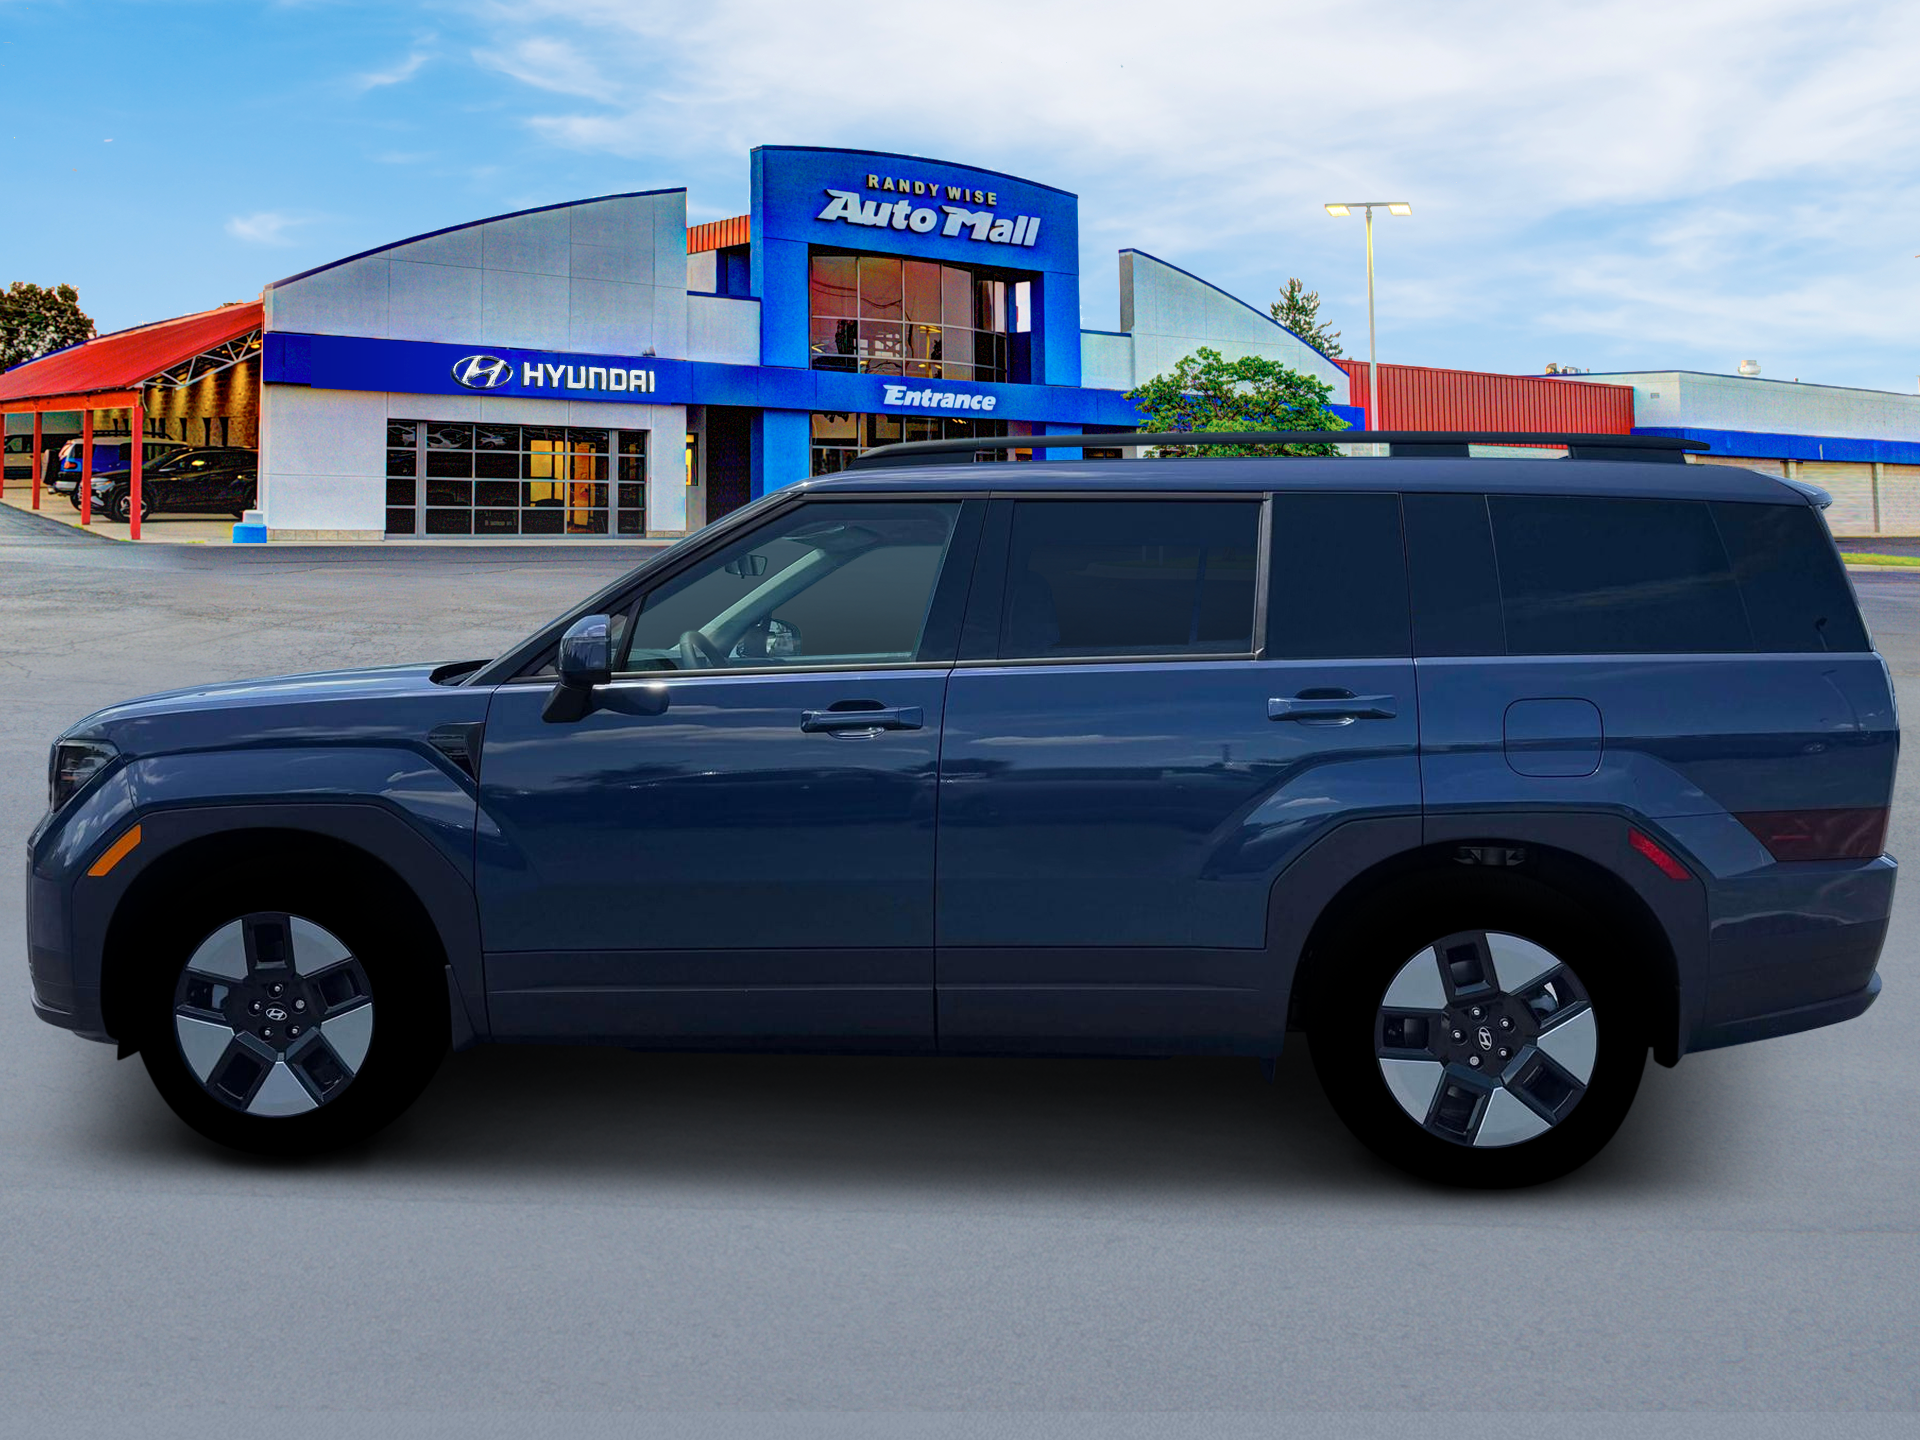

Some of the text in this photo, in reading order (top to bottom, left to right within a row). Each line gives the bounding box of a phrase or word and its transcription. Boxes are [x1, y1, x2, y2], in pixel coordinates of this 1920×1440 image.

[867, 174, 997, 206] RANDY WISE
[816, 189, 1041, 246] Auto Mall
[523, 362, 655, 392] HYUNDAI
[883, 385, 997, 411] Entrance
